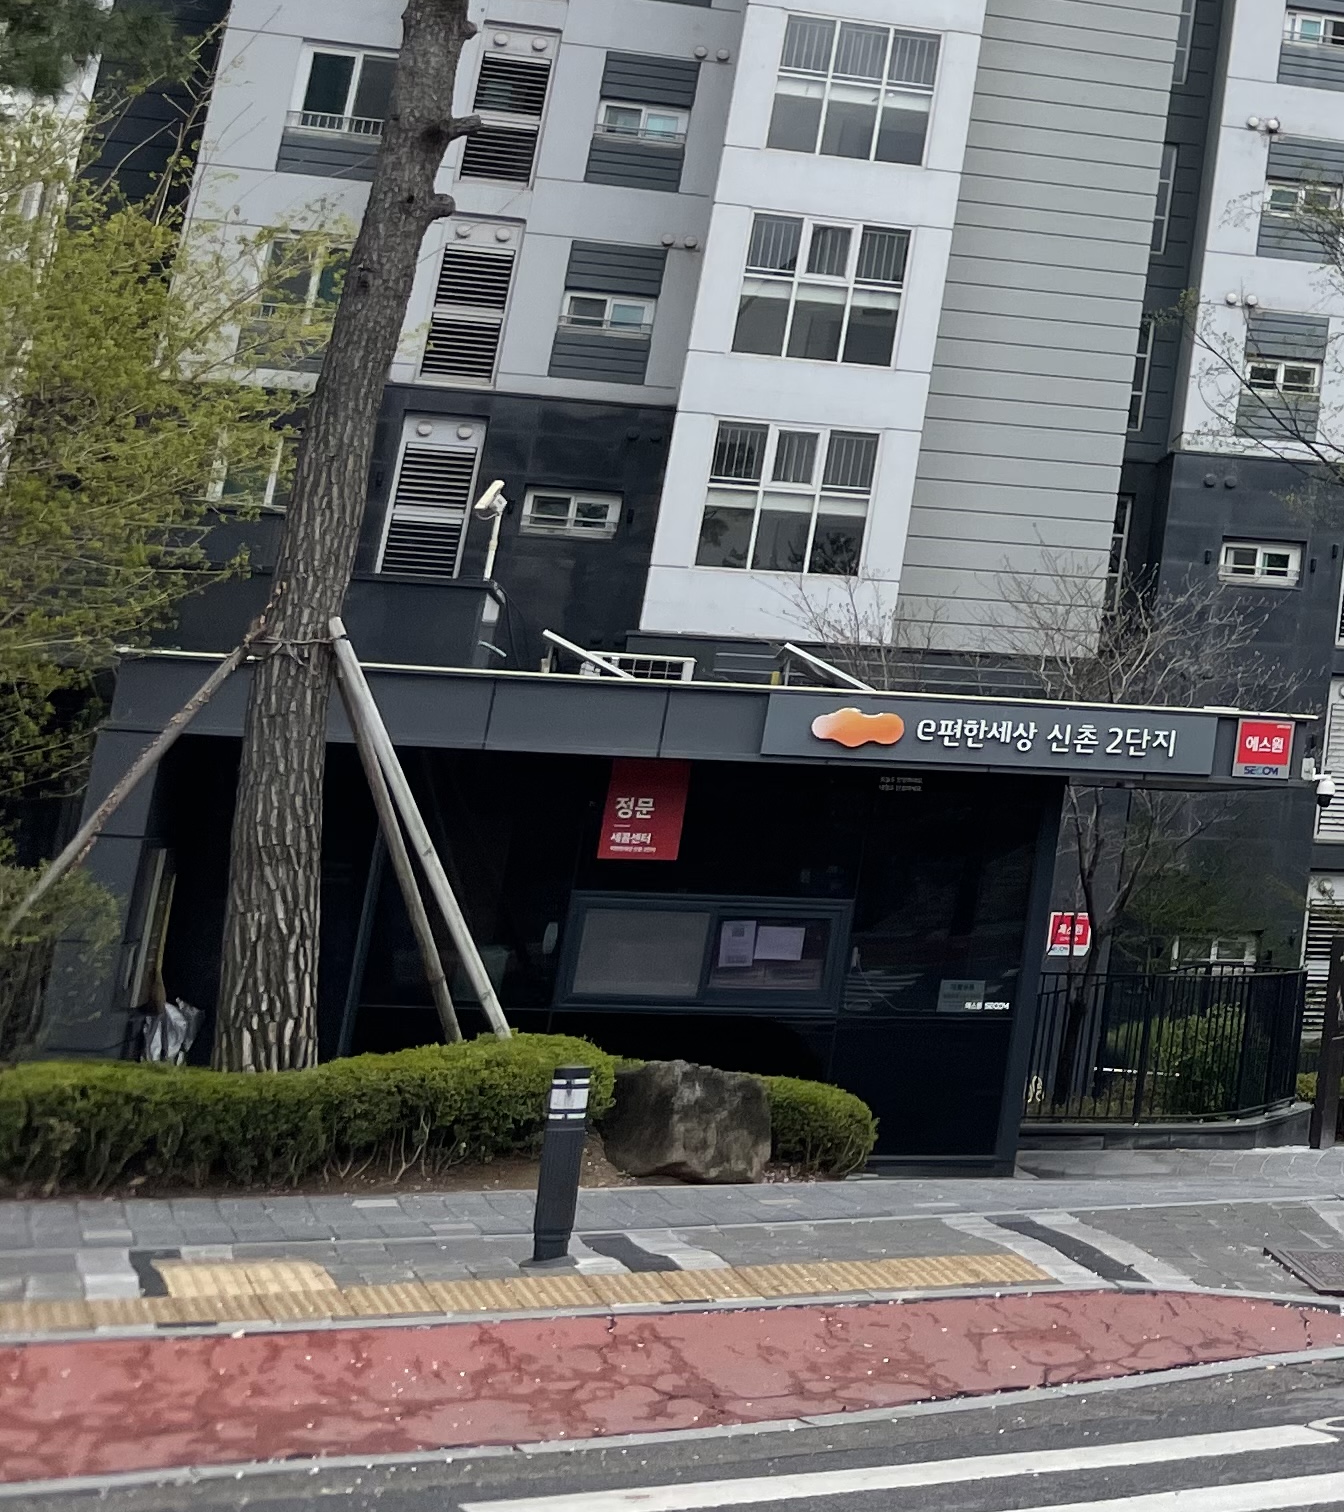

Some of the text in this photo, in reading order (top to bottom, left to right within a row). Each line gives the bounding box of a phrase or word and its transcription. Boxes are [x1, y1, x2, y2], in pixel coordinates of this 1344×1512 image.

[916, 717, 1177, 758] e편한세상 신촌 2단지
[1246, 736, 1284, 753] 에스원
[1244, 766, 1278, 775] SECOM
[615, 797, 655, 819] 정문
